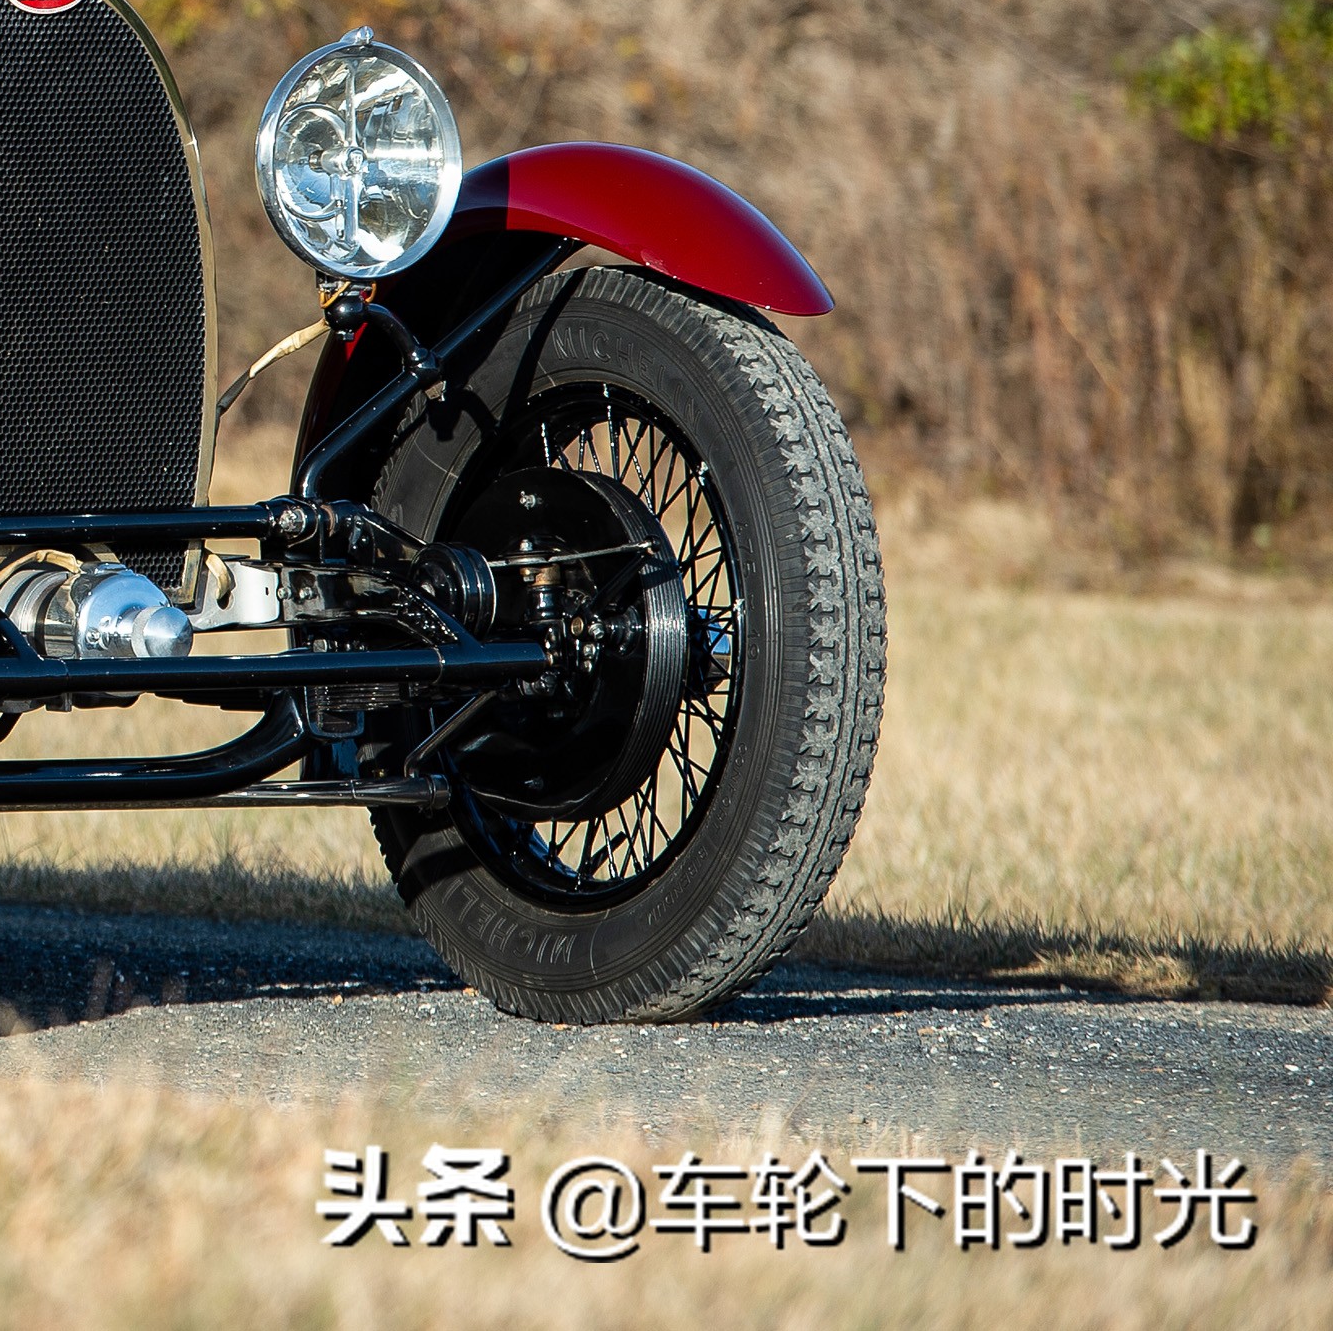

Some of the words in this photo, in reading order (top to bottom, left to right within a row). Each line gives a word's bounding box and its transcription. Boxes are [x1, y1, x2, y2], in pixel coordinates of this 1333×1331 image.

[550, 326, 703, 436] MICHELIN
[712, 742, 748, 834] CONFORT
[647, 845, 709, 927] BIBENDUM
